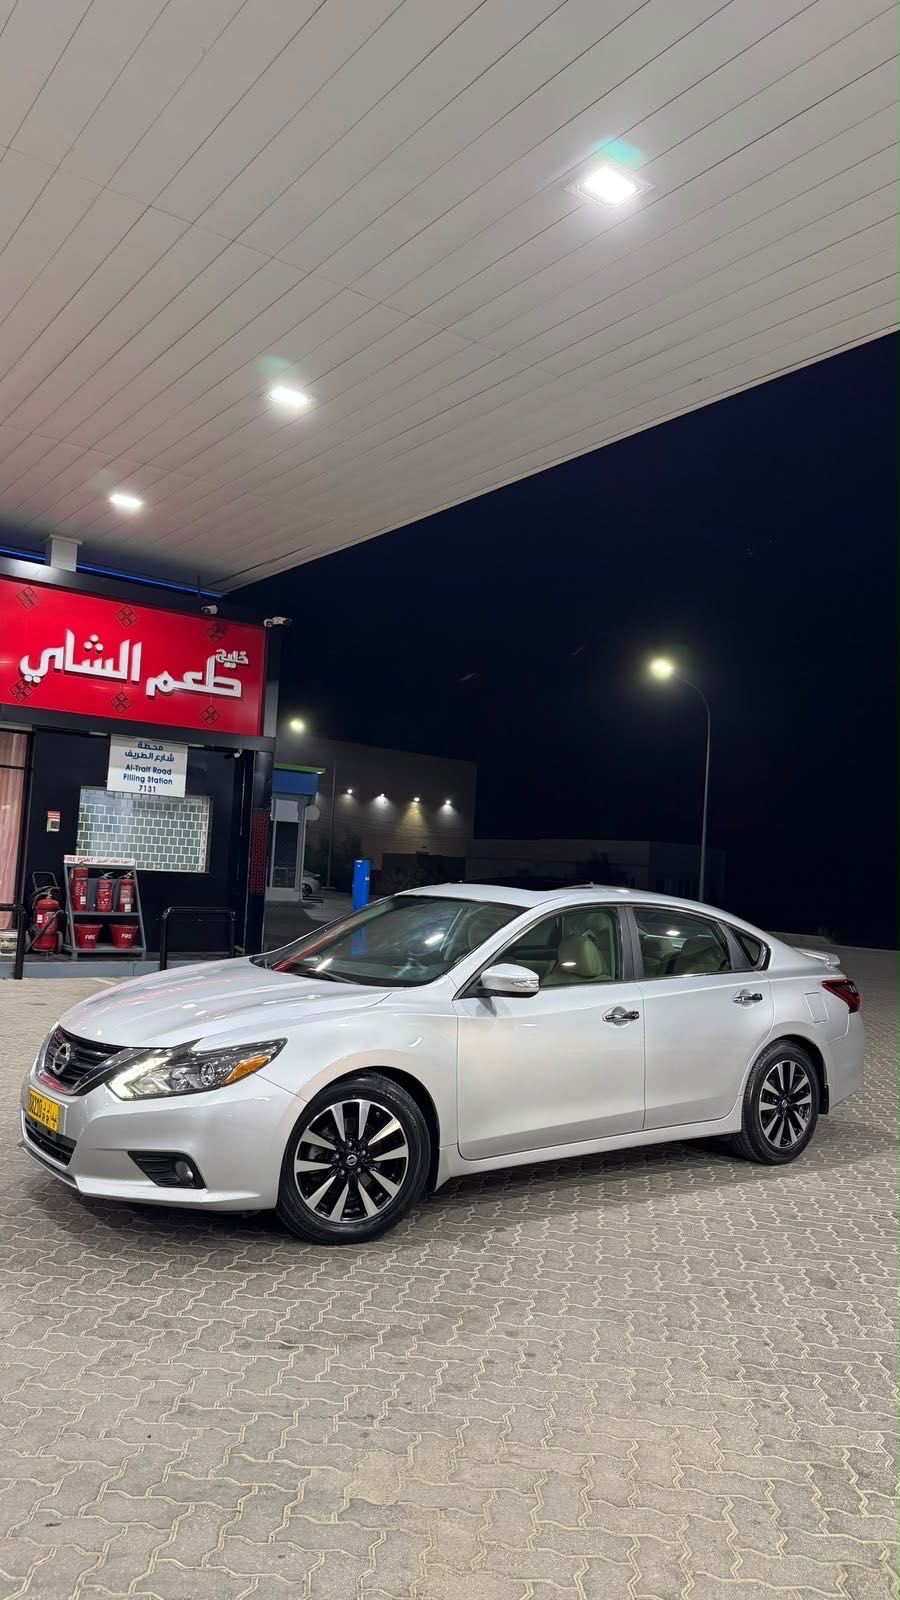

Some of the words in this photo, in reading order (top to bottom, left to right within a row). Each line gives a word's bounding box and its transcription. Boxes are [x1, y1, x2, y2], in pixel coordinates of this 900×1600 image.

[19, 628, 142, 684] الشاي
[215, 648, 249, 668] خليج
[145, 655, 242, 698] طعم
[137, 741, 164, 751] محطة
[154, 753, 175, 762] شارع
[152, 766, 172, 775] Road
[123, 773, 146, 783] Filling
[147, 776, 173, 785] Station
[138, 784, 156, 793] 7131
